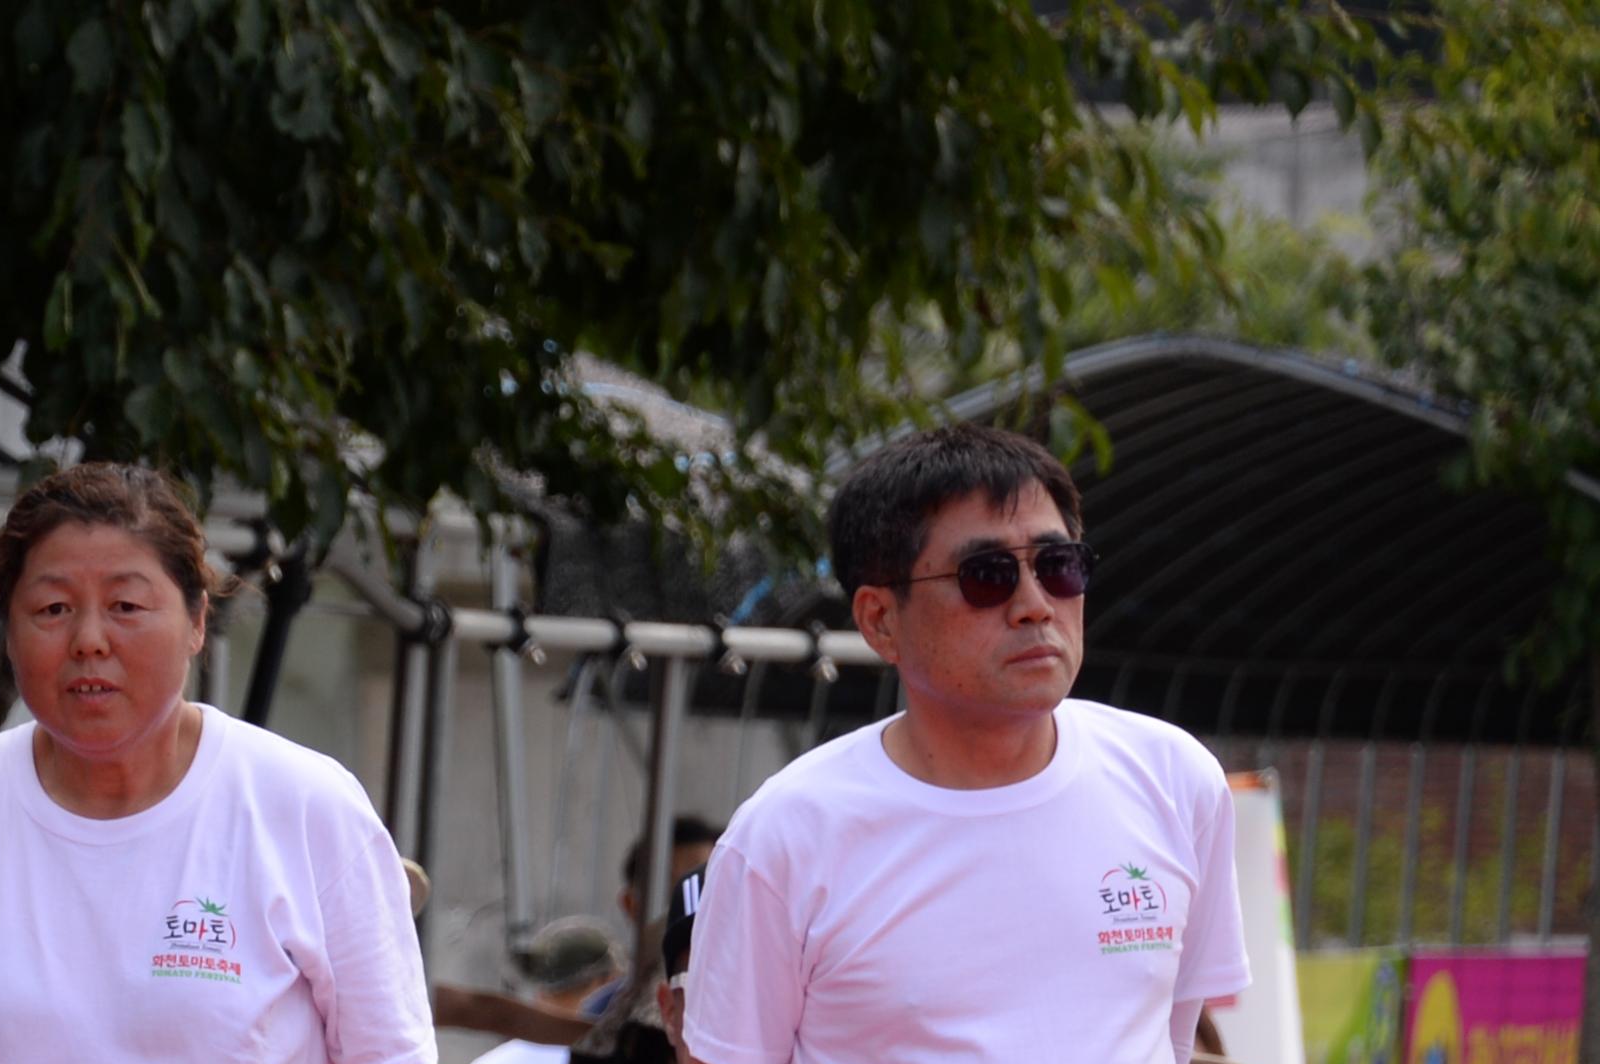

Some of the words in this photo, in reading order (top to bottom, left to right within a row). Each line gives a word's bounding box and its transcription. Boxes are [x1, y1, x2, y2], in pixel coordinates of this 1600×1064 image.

[1099, 885, 1159, 914] 토마토
[163, 915, 227, 944] 토마토
[152, 954, 241, 976] 화천토마토축제
[152, 969, 192, 977] TOMATO
[195, 971, 242, 984] FESTIVAL
